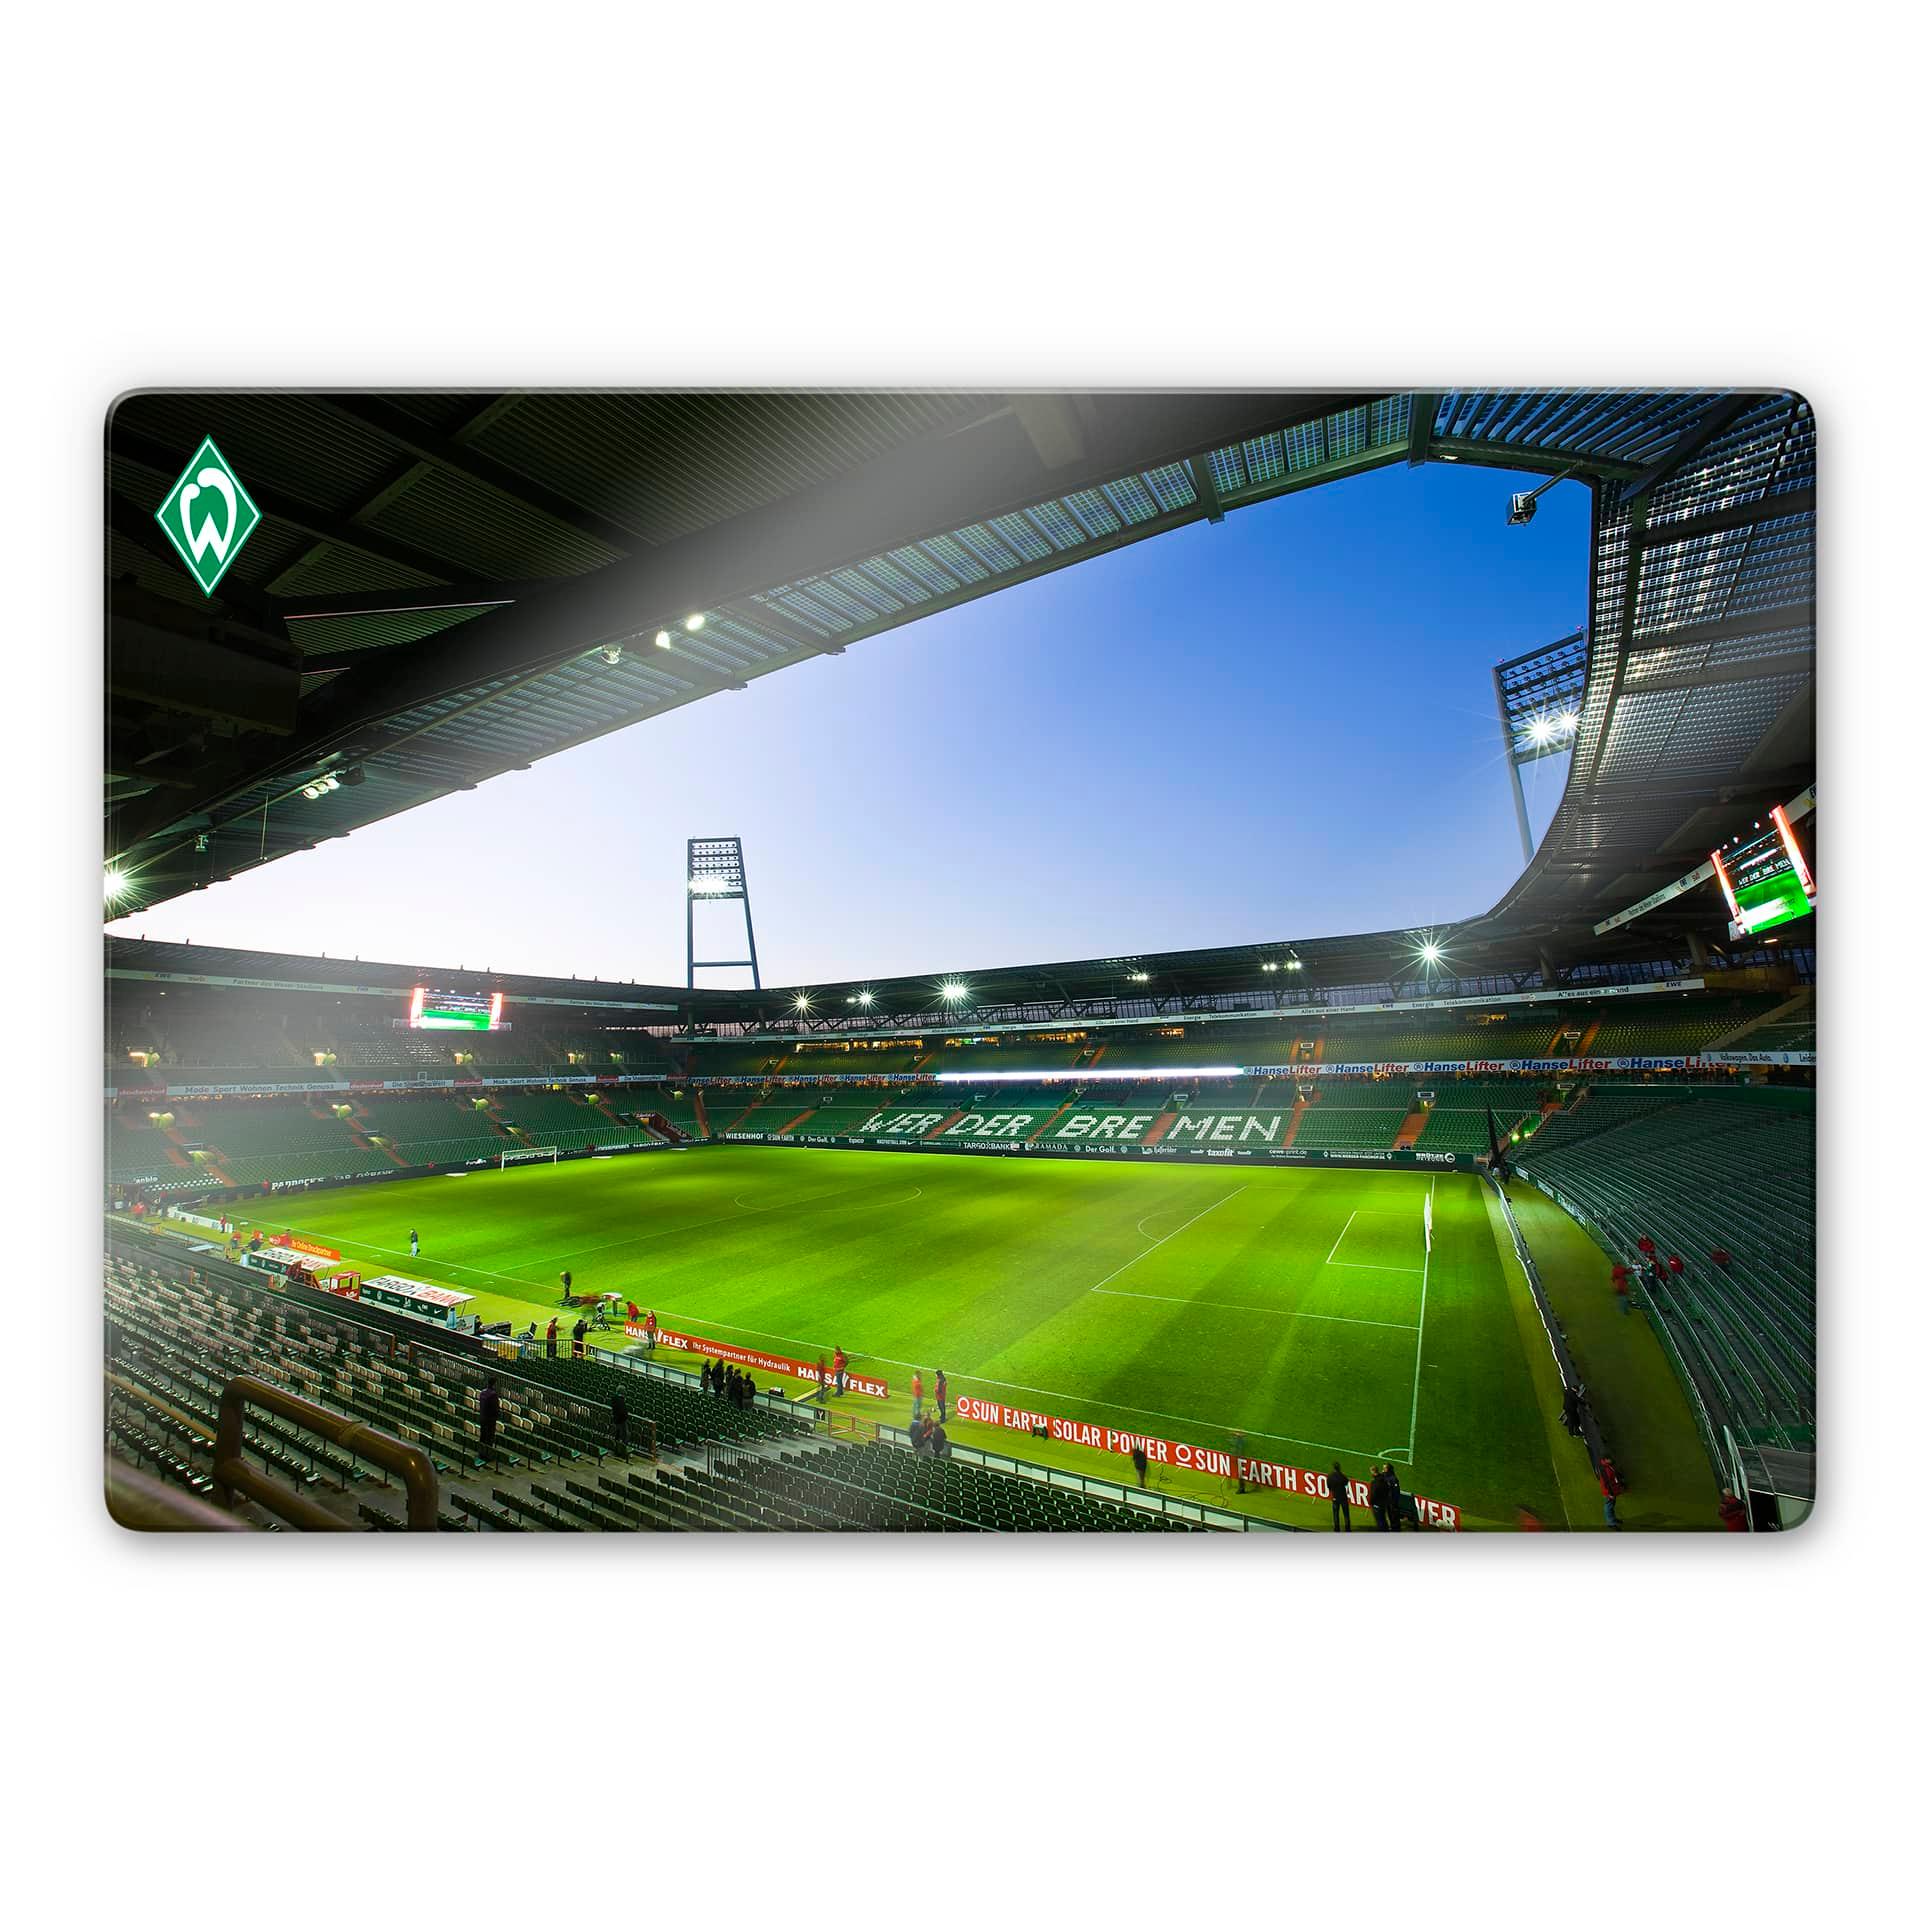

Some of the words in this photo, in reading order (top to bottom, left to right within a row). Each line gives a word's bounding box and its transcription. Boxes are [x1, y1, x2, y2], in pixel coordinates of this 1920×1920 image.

[1411, 1001, 1434, 1009] Energie
[1443, 996, 1502, 1006] Telekommunikation
[1424, 1061, 1504, 1072] HanseLifter
[1520, 1059, 1612, 1071] HanseLifter
[1630, 1056, 1725, 1068] HanseLi
[1253, 1065, 1322, 1075] HanseLifter
[1335, 1063, 1409, 1074] HanseLifter
[844, 1074, 886, 1082] HanseLifter
[893, 1073, 936, 1082] HanseLifter
[213, 1085, 236, 1094] Sport
[240, 1084, 273, 1092] Wohnen
[275, 1083, 304, 1091] Technik
[859, 1113, 943, 1133] WER
[944, 1114, 1034, 1136] DER
[1055, 1115, 1153, 1138] BRE
[1167, 1115, 1281, 1141] MEN
[726, 1132, 763, 1140] WIESENHOF
[1085, 1145, 1097, 1153] Der
[1207, 1148, 1234, 1157] taxofit
[663, 1334, 689, 1349] FLEX
[692, 1341, 702, 1350] Ihr
[702, 1342, 747, 1363] Systempartner
[747, 1354, 757, 1364] für
[758, 1356, 791, 1372] Hydraulik
[850, 1378, 886, 1398] FLEX
[972, 1400, 999, 1425] SUN
[1003, 1407, 1048, 1432] EARTH
[1053, 1418, 1101, 1448] SOLAR
[1106, 1430, 1168, 1462] POWER
[1195, 1447, 1231, 1477] SUN
[1237, 1457, 1297, 1491] EARTH
[1304, 1472, 1369, 1507] SOAR
